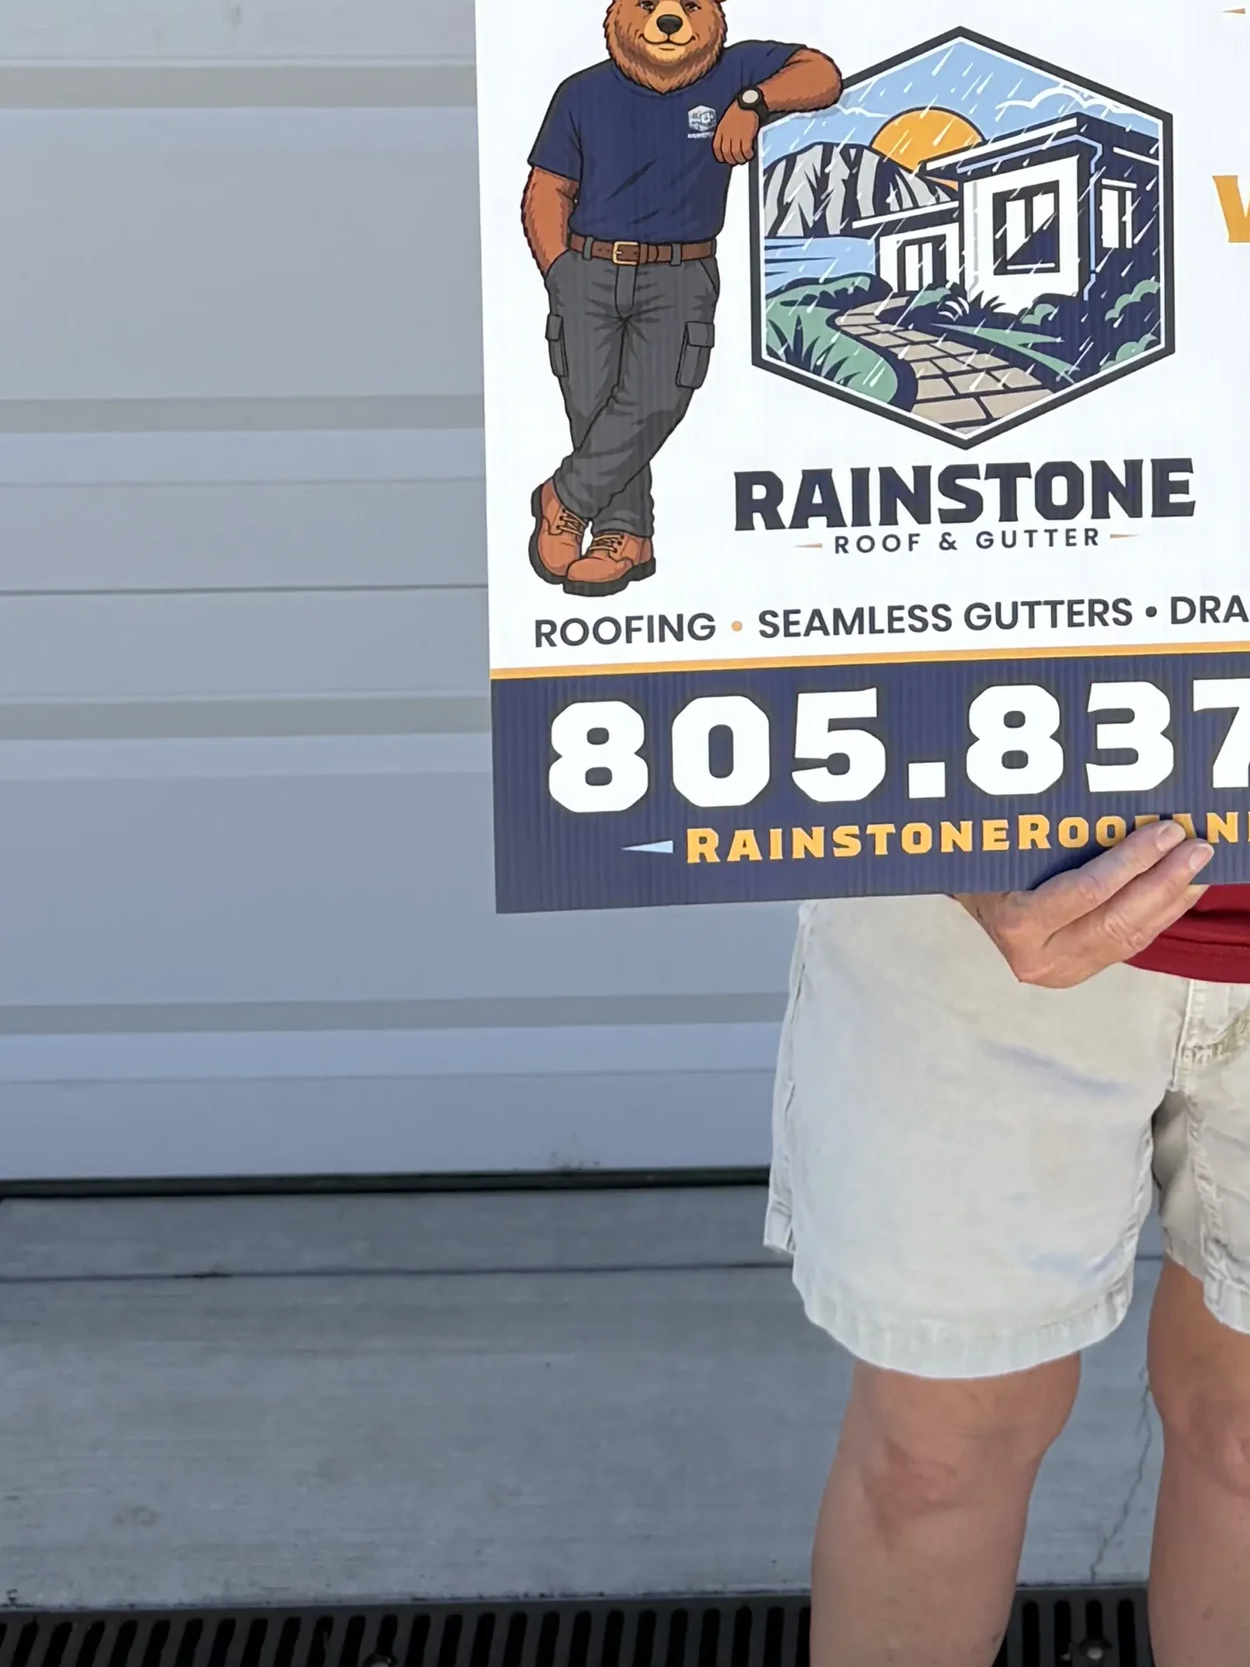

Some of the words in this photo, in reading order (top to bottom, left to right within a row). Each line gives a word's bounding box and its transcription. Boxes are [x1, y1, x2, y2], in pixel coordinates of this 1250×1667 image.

[733, 457, 1196, 531] RAINSTONE
[834, 532, 921, 555] ROOF
[938, 531, 958, 551] &
[975, 527, 1099, 550] GUTTER
[535, 612, 716, 648] ROOFING
[758, 603, 953, 639] SEAMLESS
[964, 597, 1133, 631] GUTTERS
